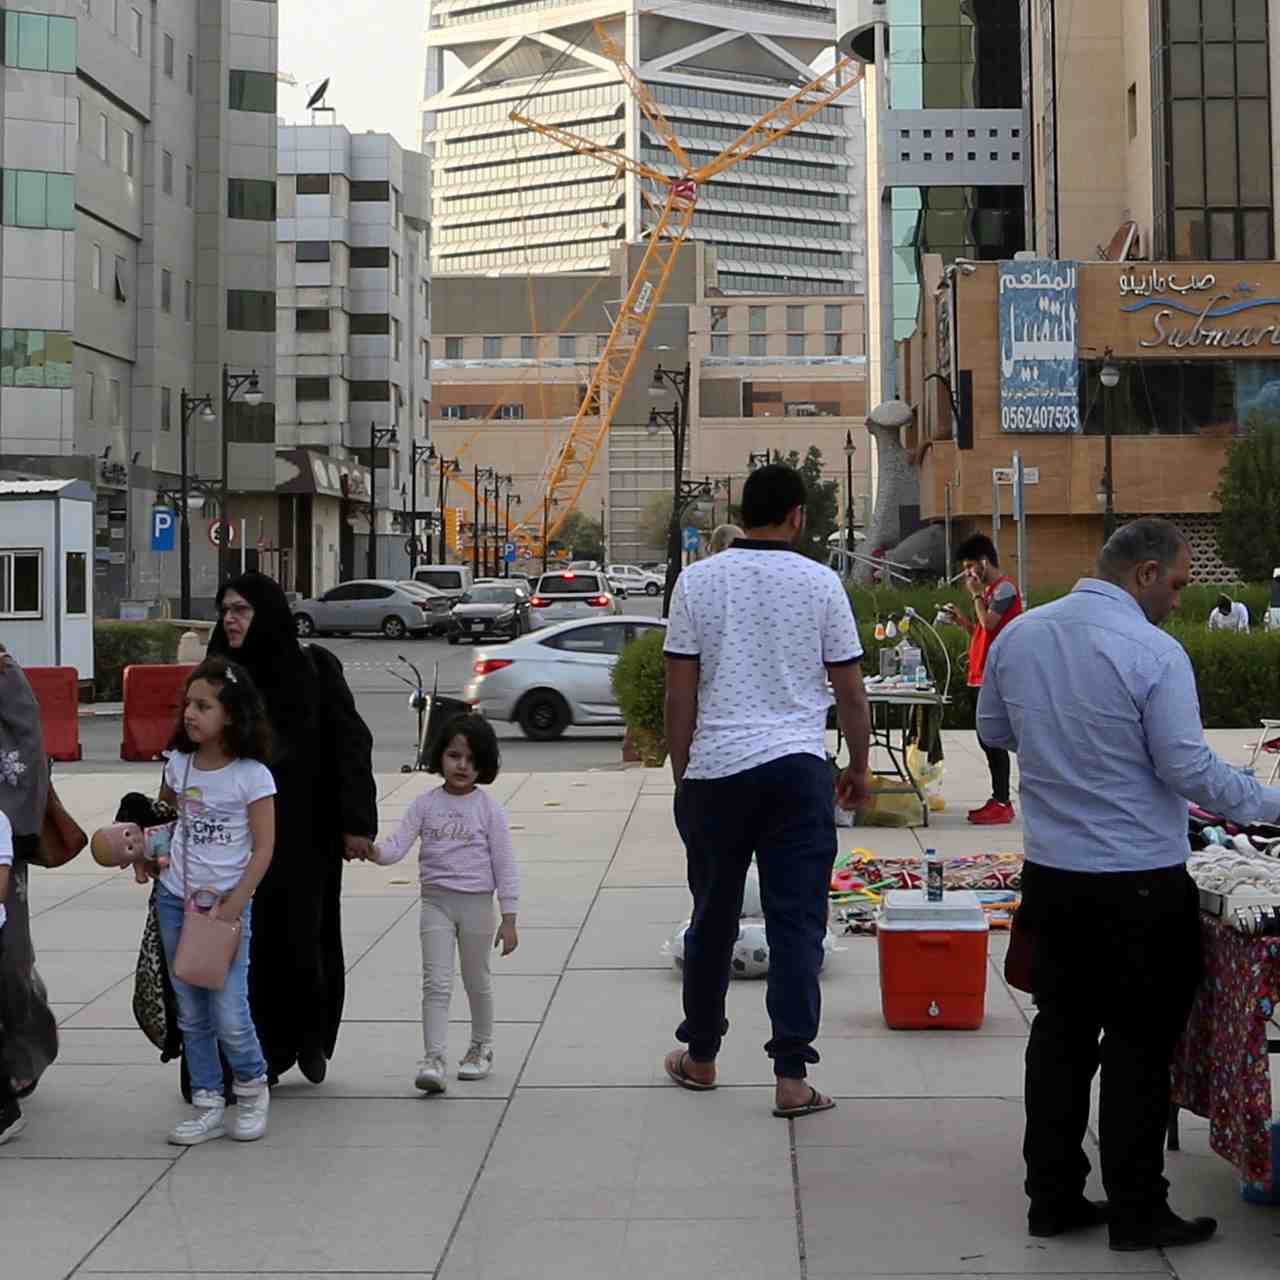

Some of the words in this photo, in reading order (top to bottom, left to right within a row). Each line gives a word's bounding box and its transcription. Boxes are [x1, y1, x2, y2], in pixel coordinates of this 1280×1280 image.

[1000, 267, 1076, 294] المطعم
[1168, 272, 1216, 294] صب
[1002, 296, 1076, 382] للتقبيل
[1001, 405, 1079, 430] 0562407533
[154, 513, 172, 538] P
